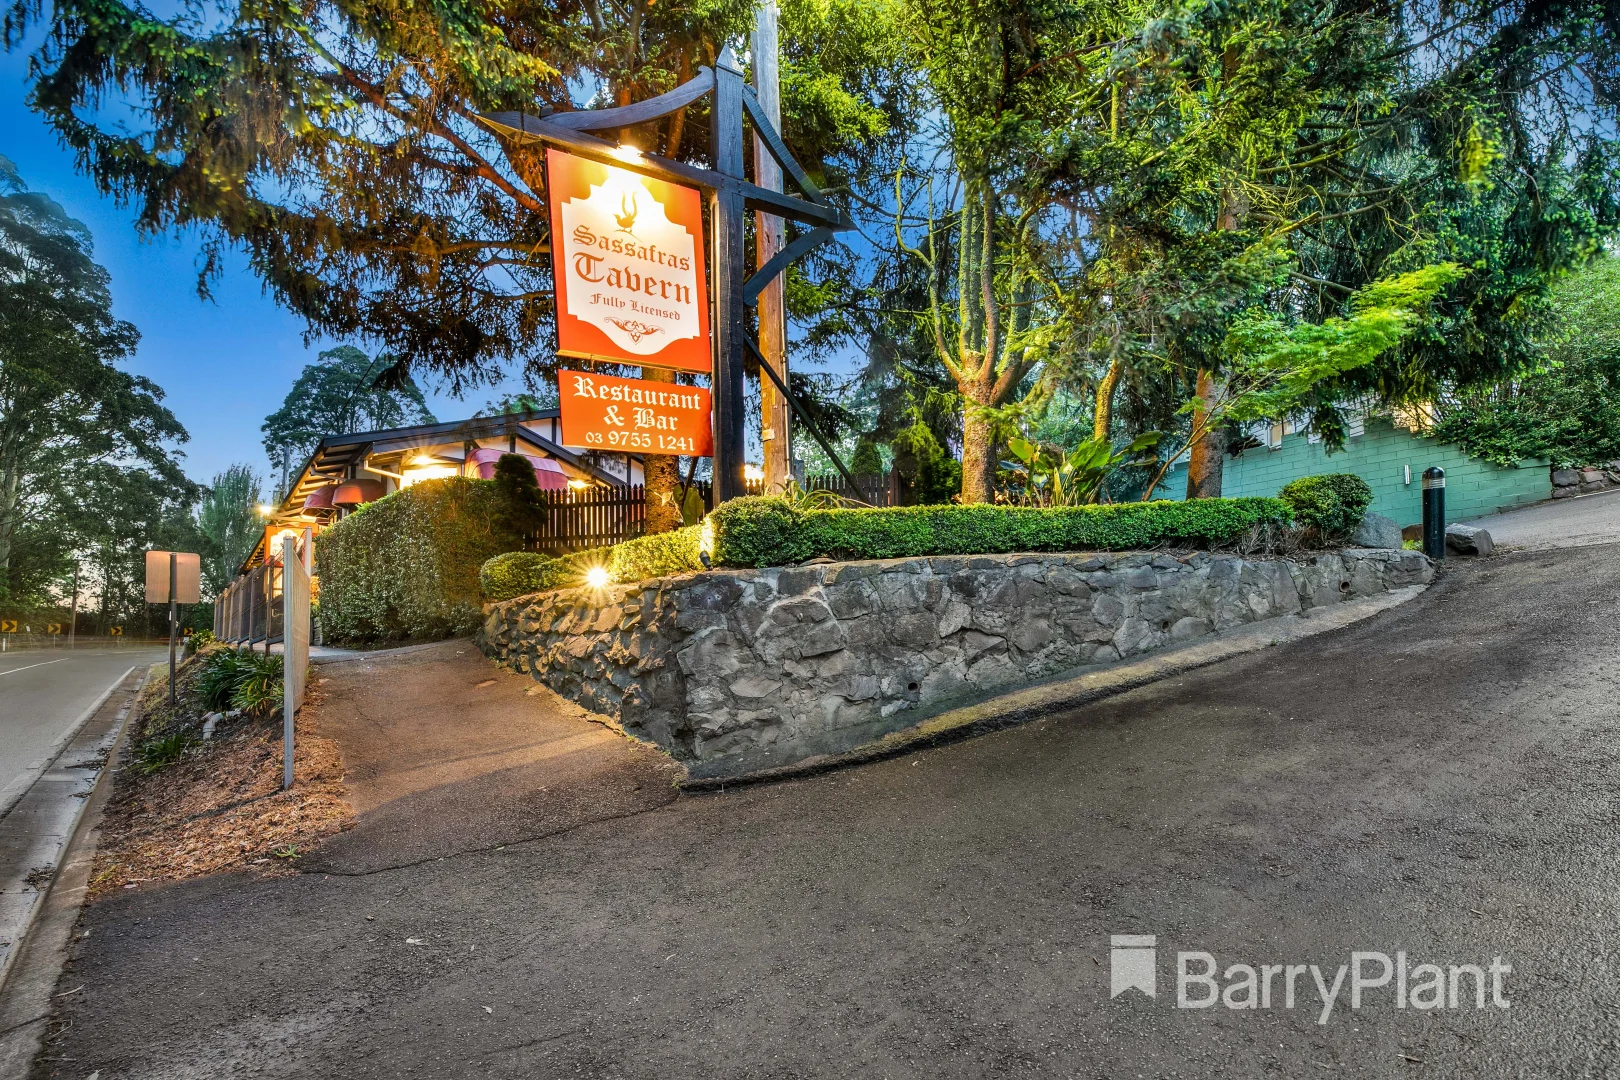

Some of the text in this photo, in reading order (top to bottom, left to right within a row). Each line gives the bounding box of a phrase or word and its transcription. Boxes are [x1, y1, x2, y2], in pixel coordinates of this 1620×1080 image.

[573, 224, 690, 271] Sassafras
[572, 251, 692, 305] Tavern
[589, 293, 681, 321] Fully Licensed
[573, 375, 701, 410] Restaurant
[603, 405, 679, 430] & Bar
[585, 430, 695, 451] 03 9755 1241
